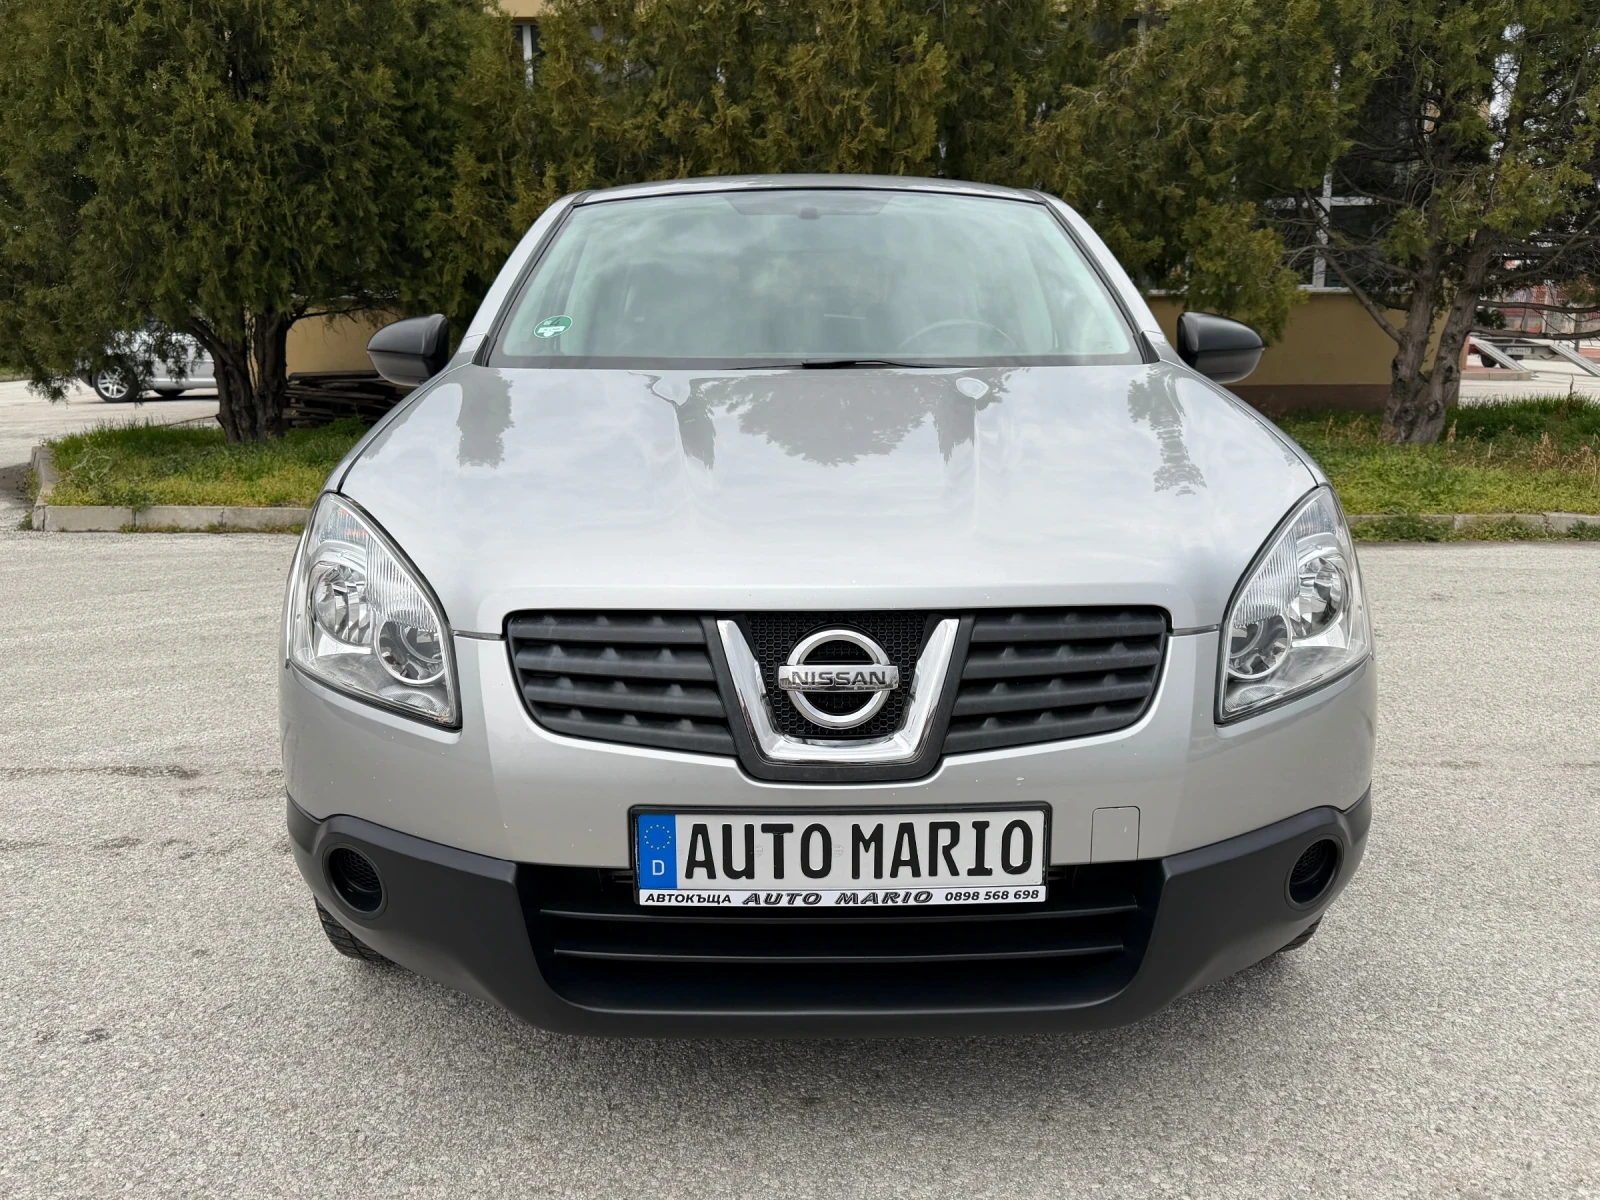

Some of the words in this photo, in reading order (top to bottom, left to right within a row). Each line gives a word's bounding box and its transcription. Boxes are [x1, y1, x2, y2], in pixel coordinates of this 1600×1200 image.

[791, 671, 886, 686] NISSAN
[685, 823, 832, 880] AUTO
[851, 819, 1033, 880] MARIO
[652, 859, 665, 876] D
[645, 893, 732, 904] АВТОКЪЩА
[742, 892, 822, 905] AUTO
[835, 891, 934, 904] MARIO
[944, 891, 980, 901] 0898
[983, 890, 1009, 900] 568
[1013, 889, 1039, 900] 698
